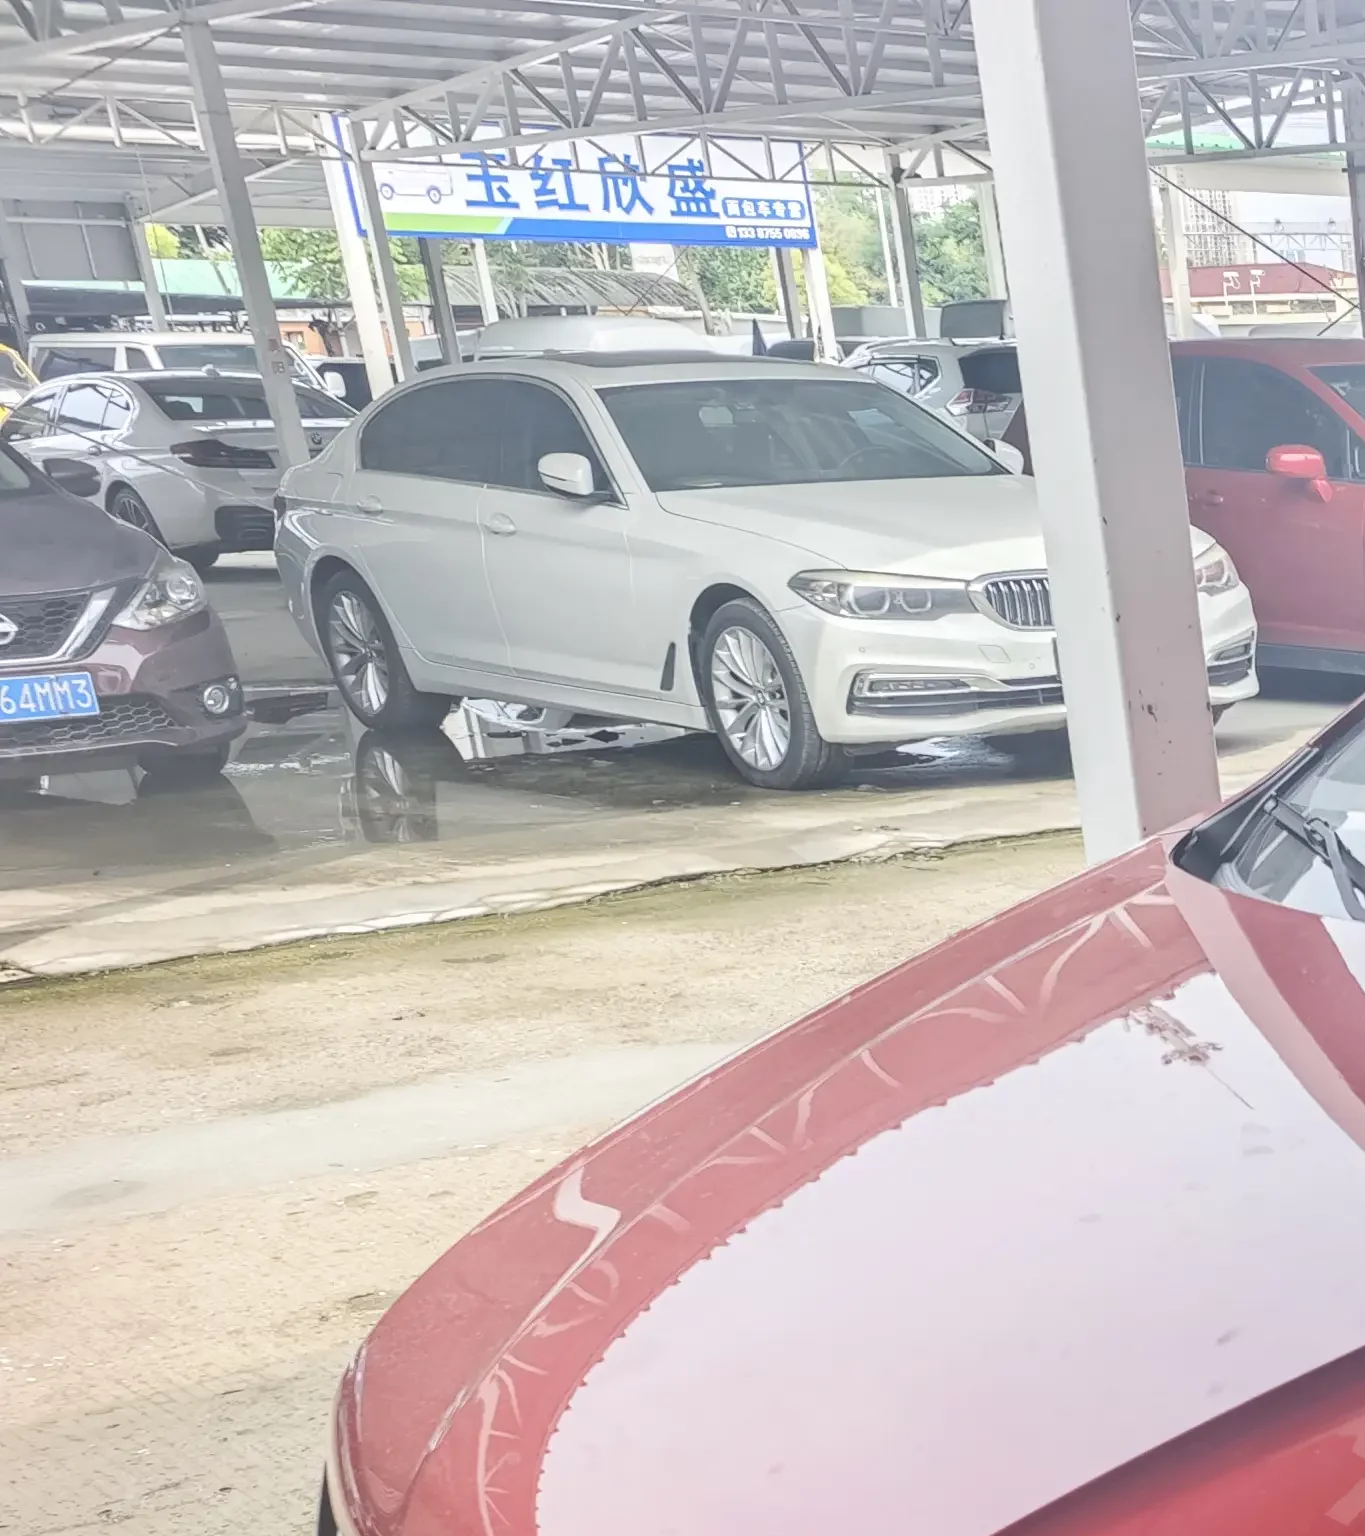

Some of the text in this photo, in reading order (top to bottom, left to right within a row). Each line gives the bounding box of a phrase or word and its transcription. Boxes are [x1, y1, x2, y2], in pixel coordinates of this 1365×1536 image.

[460, 151, 721, 219] 玉红欣盛
[0, 679, 93, 715] 64MM3
